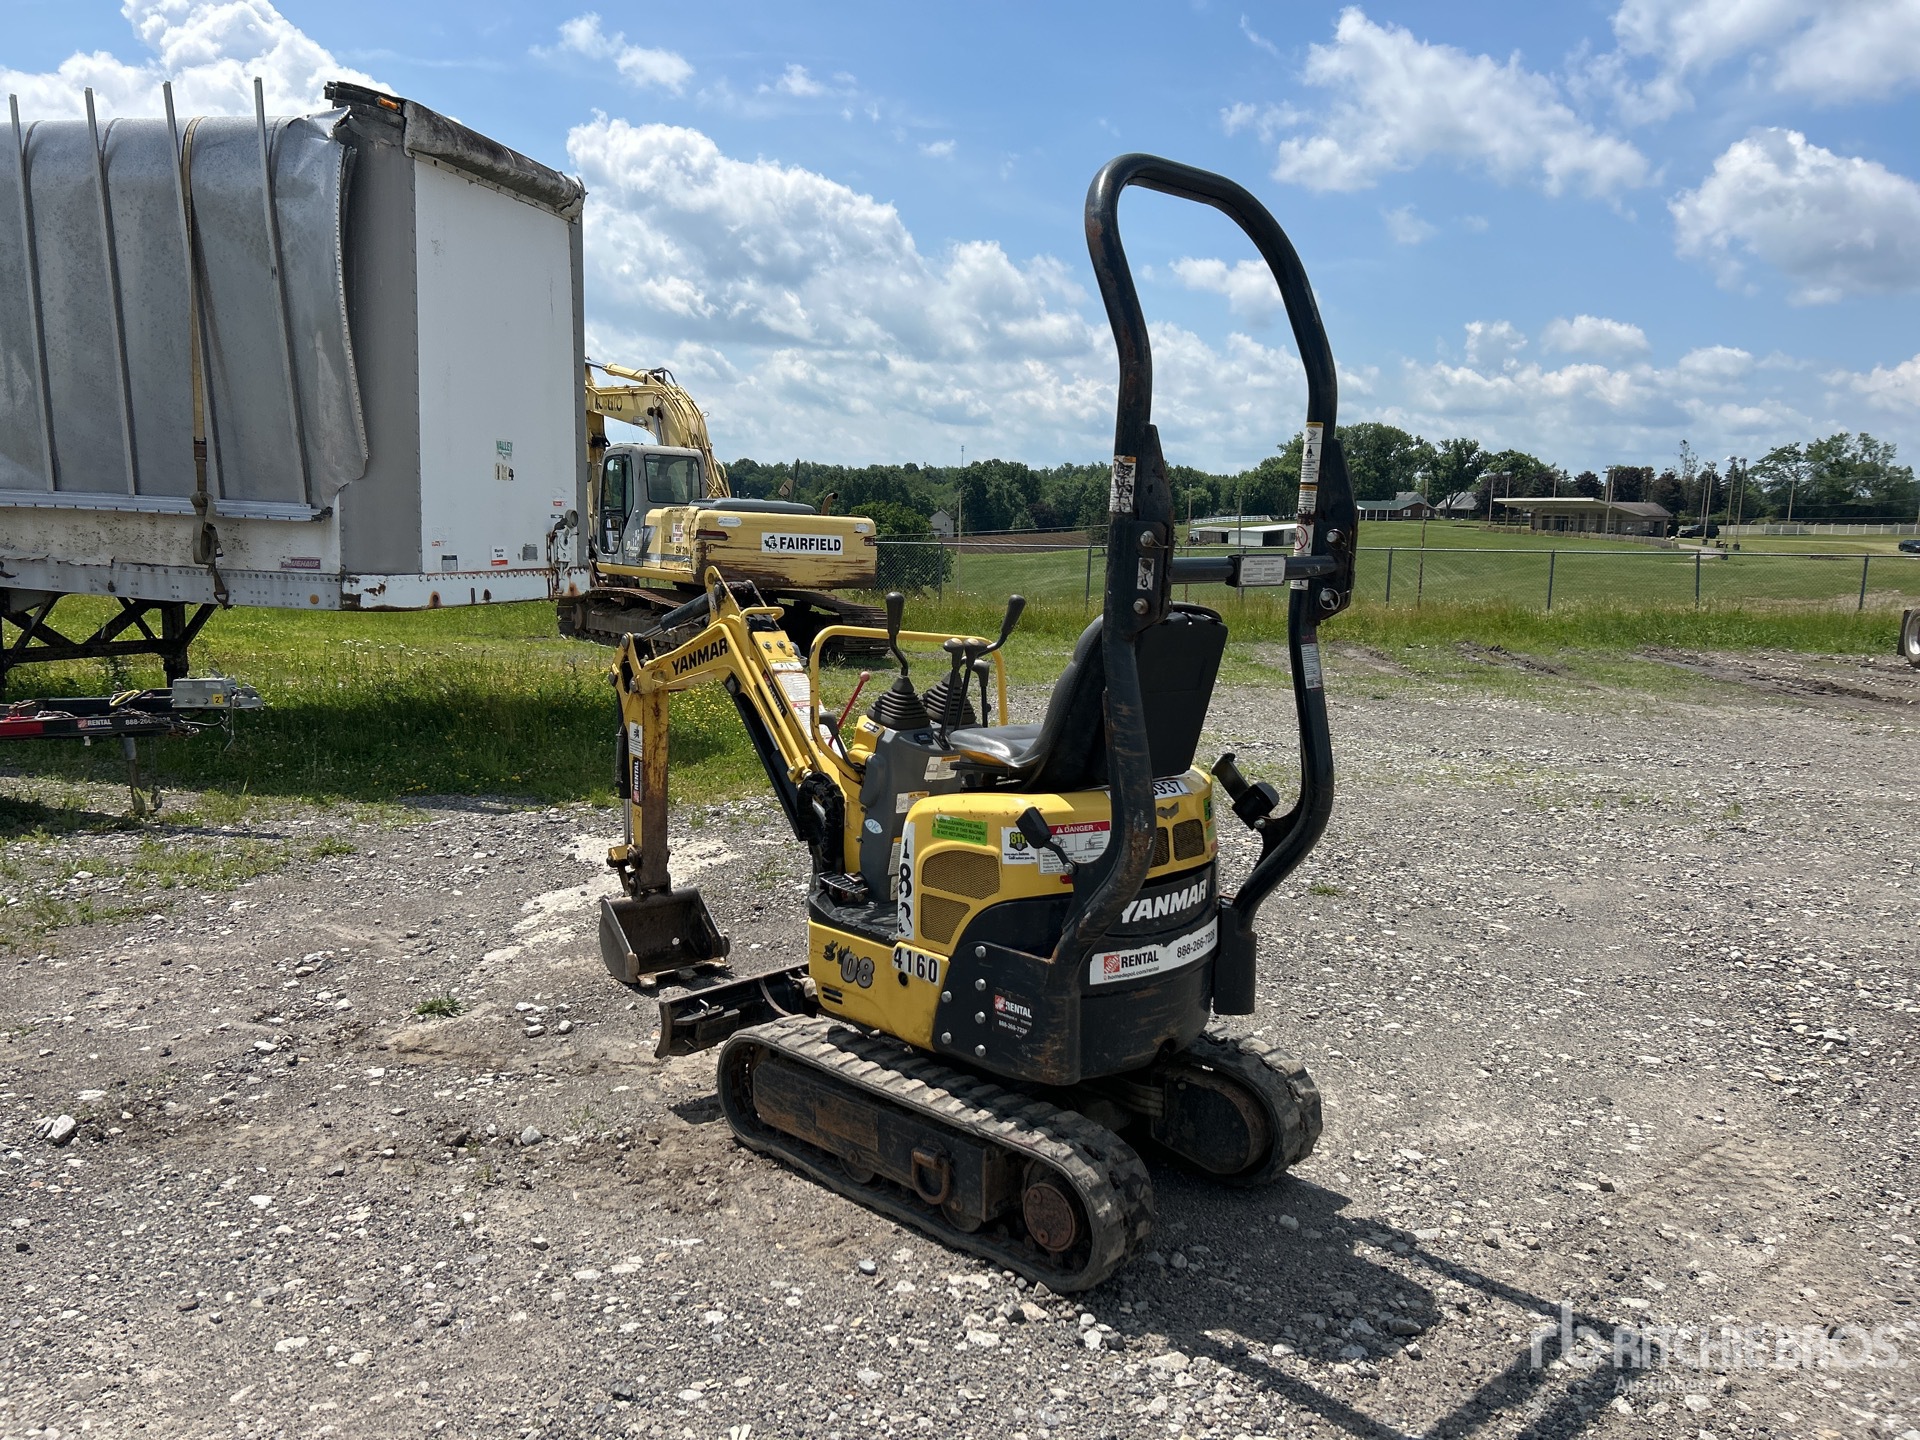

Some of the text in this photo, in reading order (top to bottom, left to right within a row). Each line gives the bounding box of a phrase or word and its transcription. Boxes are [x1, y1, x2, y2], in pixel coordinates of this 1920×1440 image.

[779, 536, 842, 551] FAIRFIELD
[671, 637, 728, 675] YANMAR
[87, 718, 112, 726] RENTAL
[1064, 824, 1094, 833] DANGER
[1010, 831, 1026, 845] 811
[1121, 879, 1207, 924] YANMAR
[893, 947, 938, 983] 4160
[1121, 950, 1159, 968] RENTAL
[1107, 966, 1160, 980] homedepot.com/rental
[1005, 1000, 1033, 1018] RENTAL
